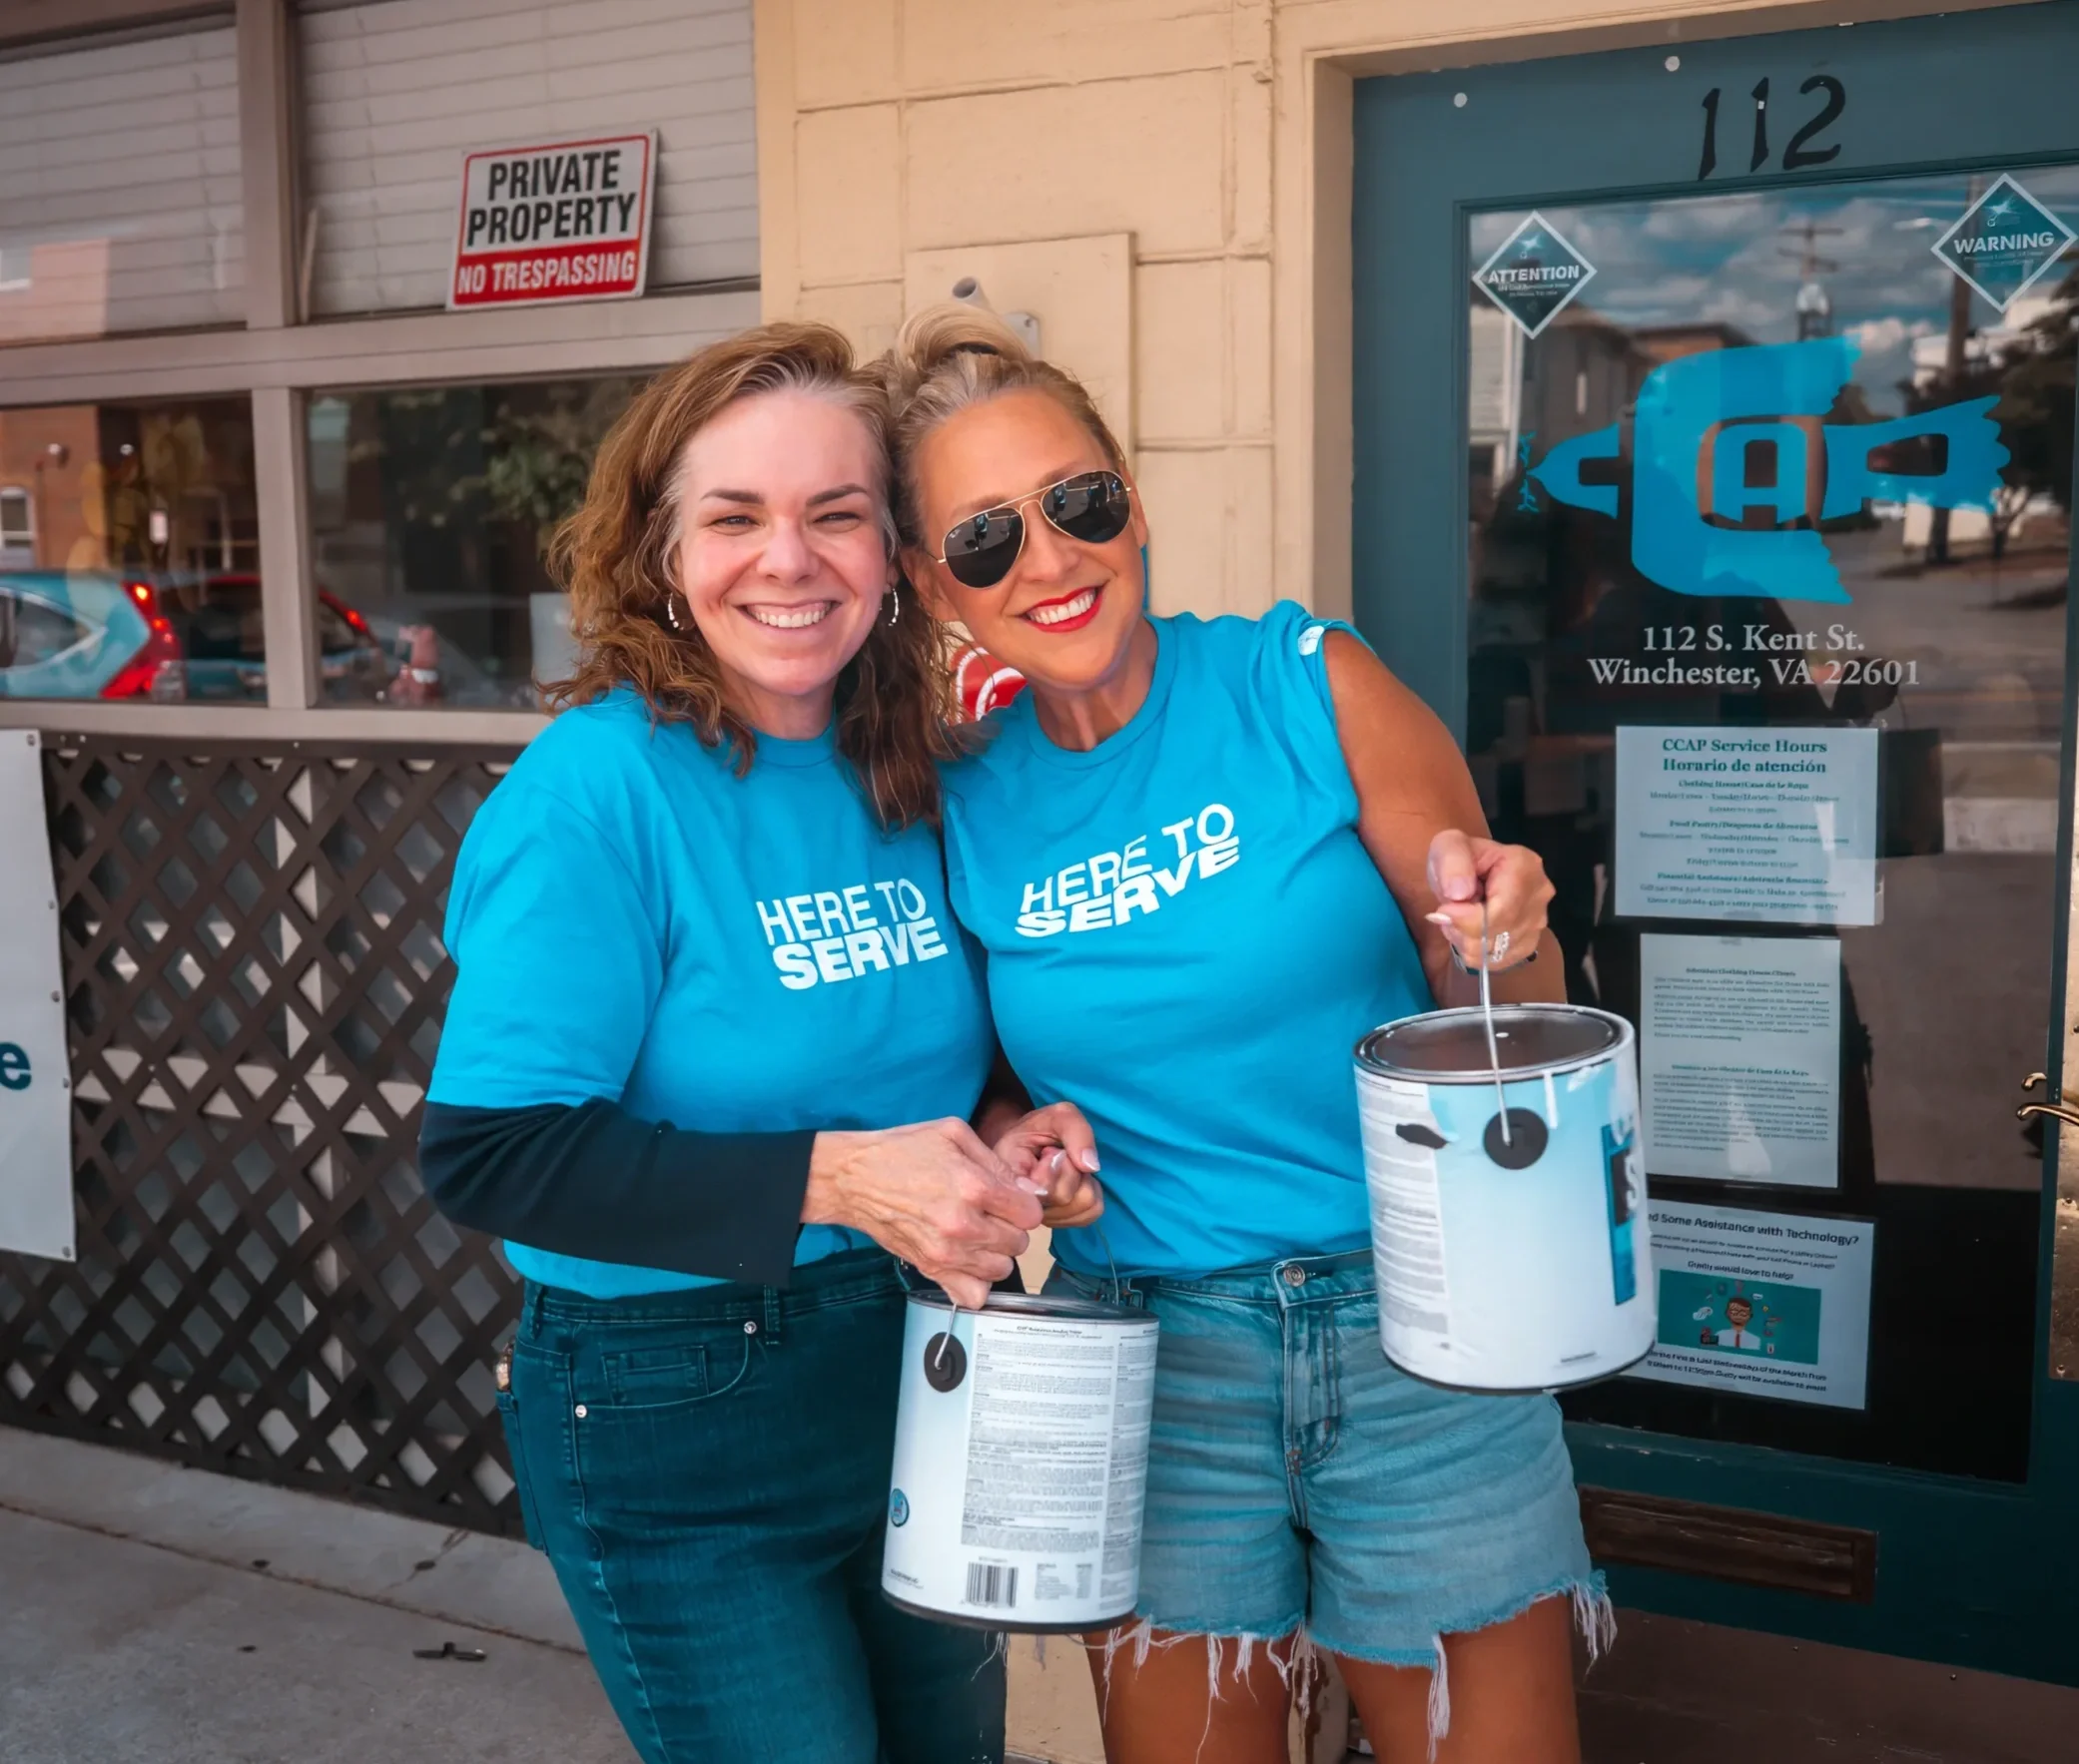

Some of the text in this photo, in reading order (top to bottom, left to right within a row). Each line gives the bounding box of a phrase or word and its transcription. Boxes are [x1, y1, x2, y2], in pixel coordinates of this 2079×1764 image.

[1698, 74, 1846, 182] 112
[488, 150, 620, 202] PRIVATE
[466, 193, 636, 248] PROPERTY
[1953, 231, 2055, 255] WARNING
[457, 251, 636, 294] NO TRESPASSING
[1488, 265, 1580, 285] ATTENTION
[1643, 624, 1866, 652] 112 S. Kent St.
[1586, 657, 1920, 690] Winchester, VA 22601
[1663, 738, 1828, 754] CCAP Service Hours
[1663, 758, 1826, 773] Horario de atención
[1020, 803, 1235, 914] HERE TO
[1015, 836, 1240, 937] SERVE
[756, 878, 927, 945] HERE TO
[772, 916, 949, 990] SERVE
[1661, 1213, 1692, 1227] Some
[1695, 1217, 1754, 1234] Assistance
[1756, 1226, 1782, 1237] with
[1786, 1228, 1859, 1247] Technology?
